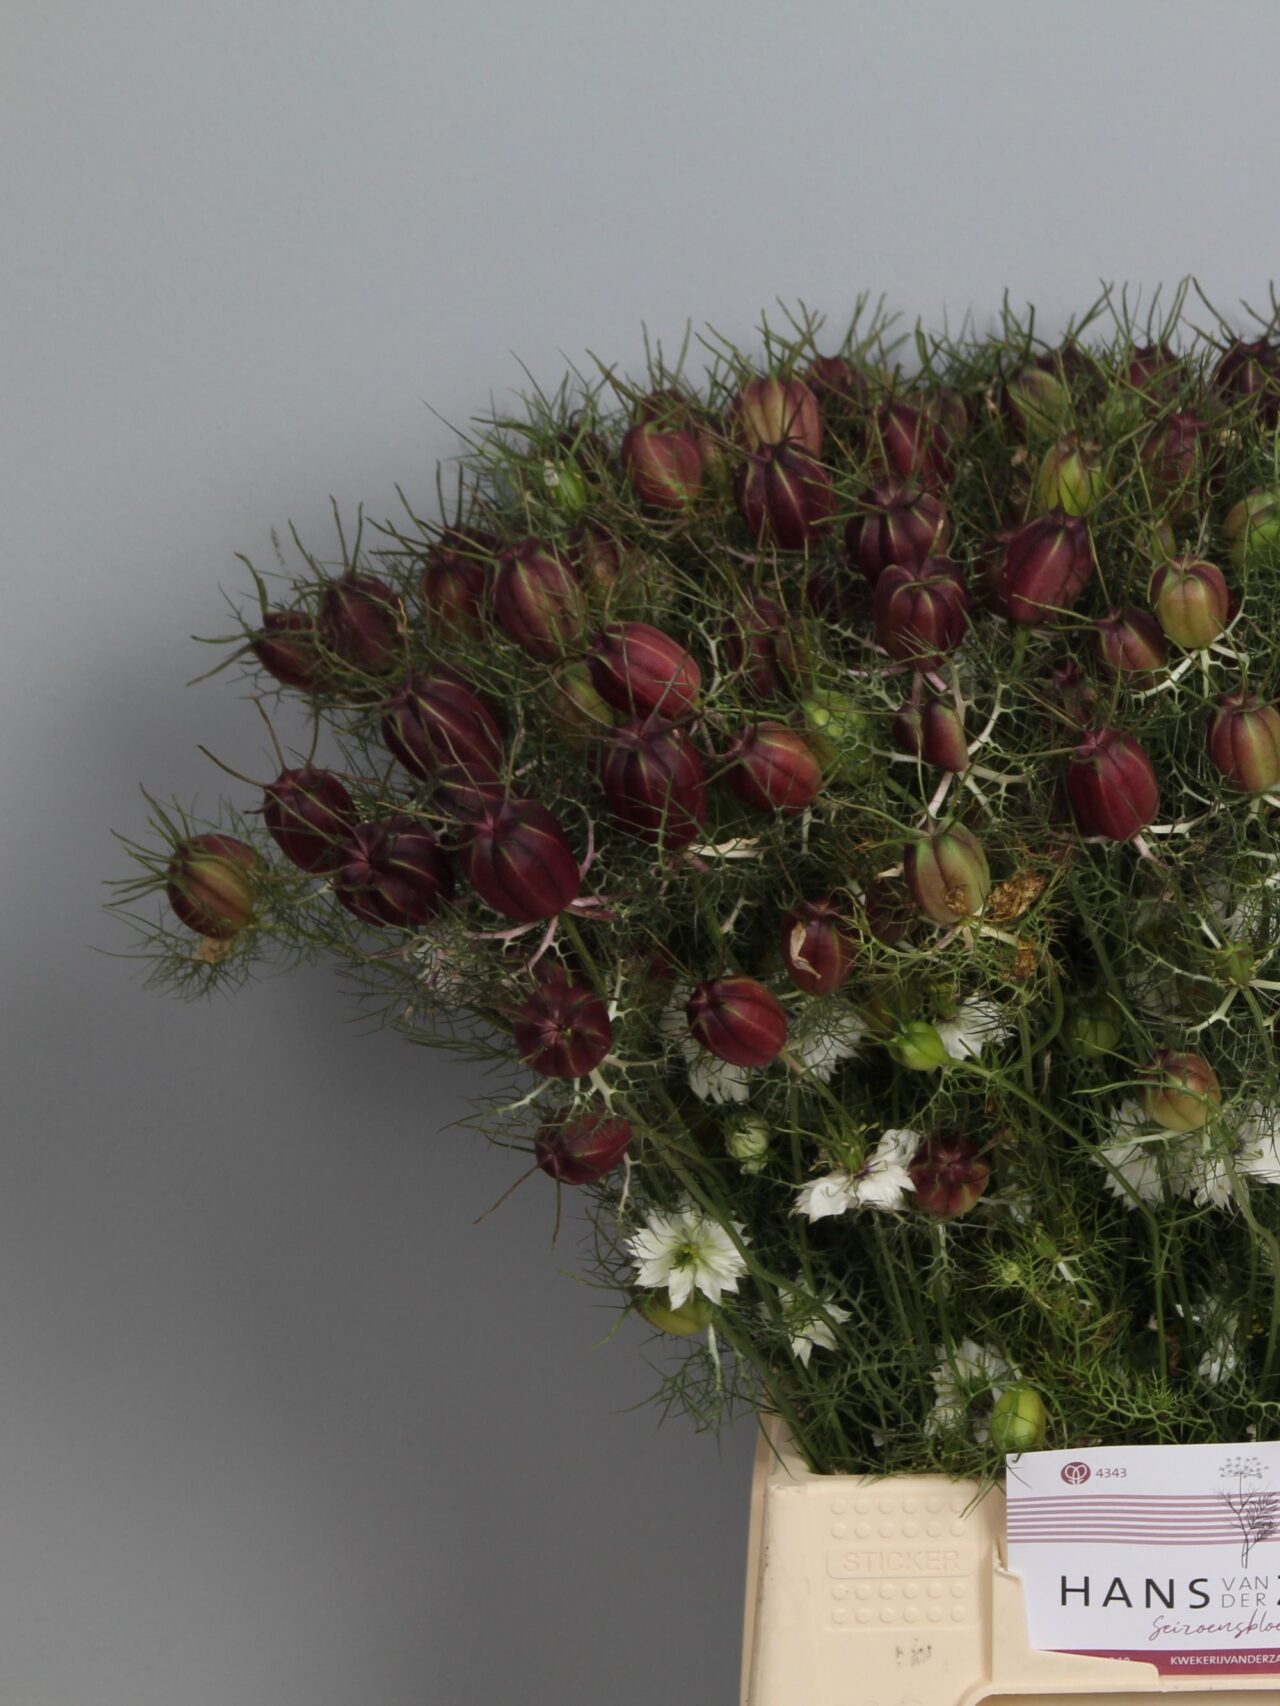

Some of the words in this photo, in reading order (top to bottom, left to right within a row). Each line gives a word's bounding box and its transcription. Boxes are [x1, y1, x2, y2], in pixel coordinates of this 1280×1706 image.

[1095, 1467, 1128, 1479] 4343
[842, 1550, 961, 1572] STICKER
[1222, 1575, 1269, 1592] VAN
[1060, 1575, 1211, 1610] HANS
[1221, 1592, 1267, 1609] DER
